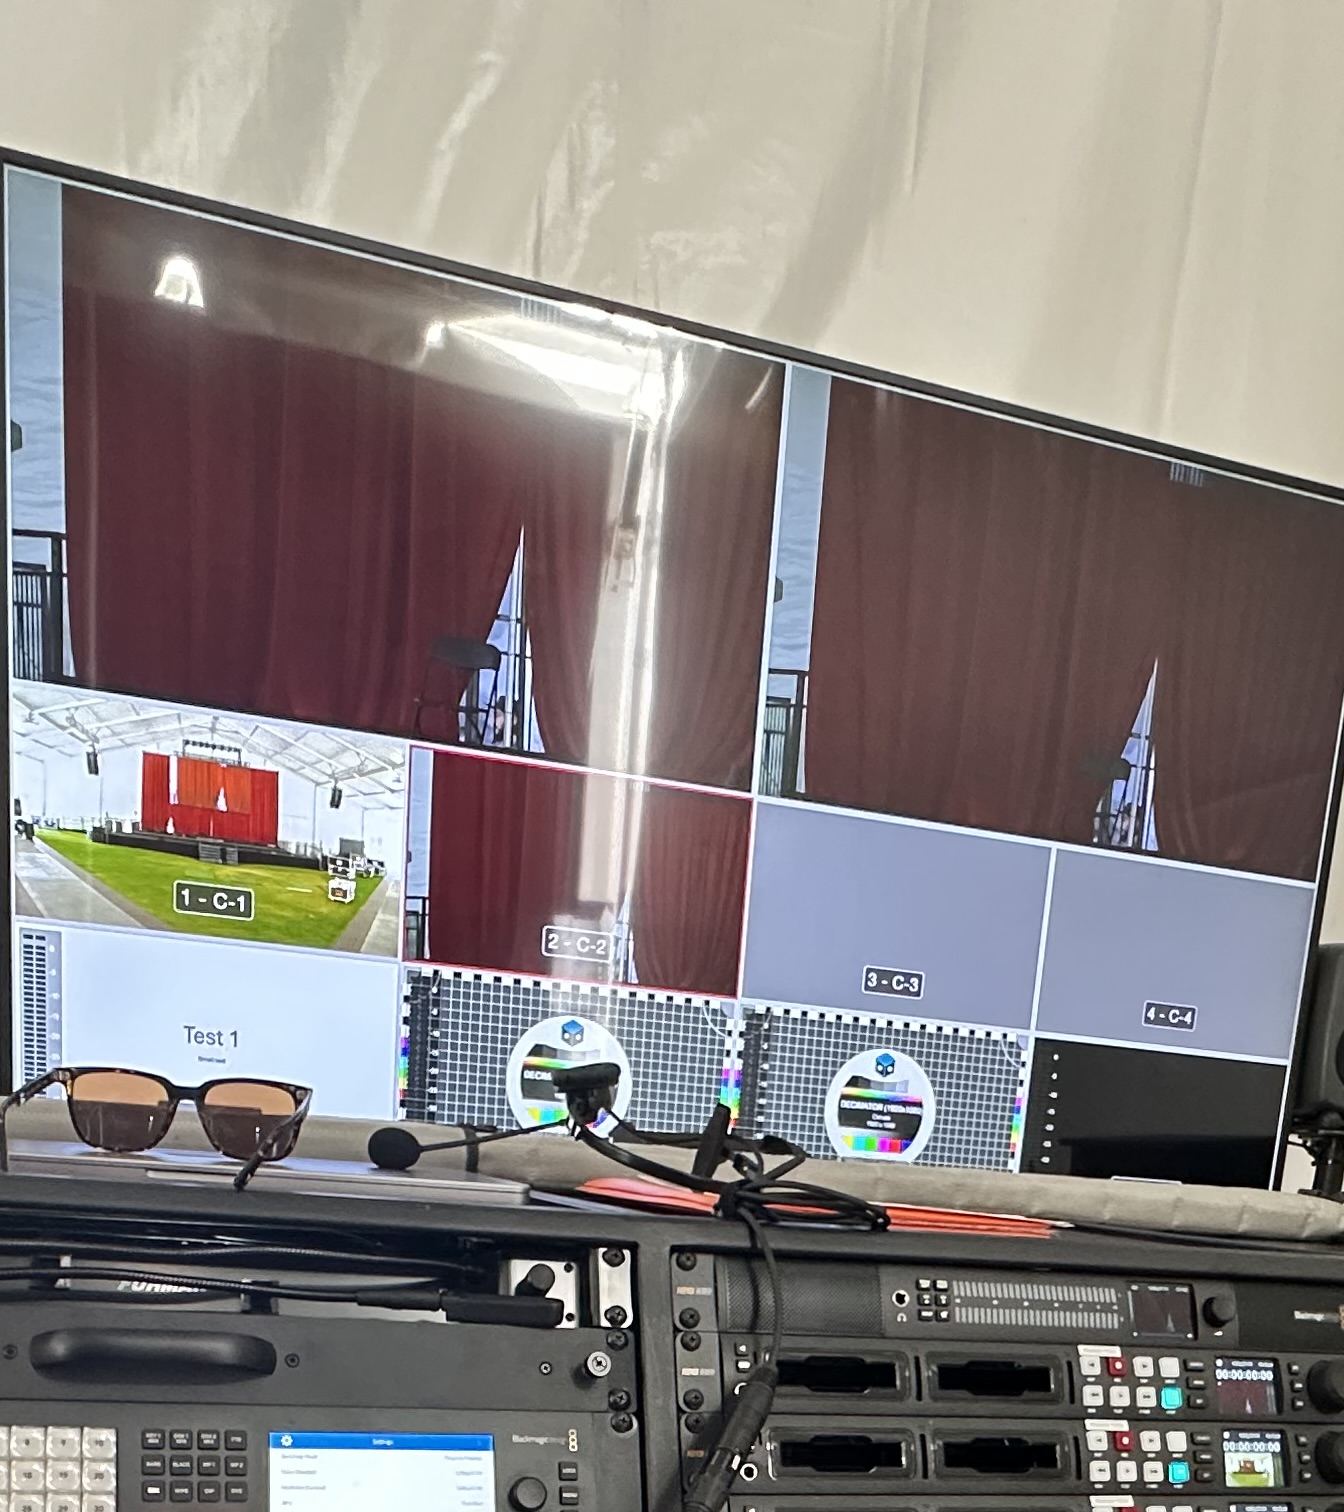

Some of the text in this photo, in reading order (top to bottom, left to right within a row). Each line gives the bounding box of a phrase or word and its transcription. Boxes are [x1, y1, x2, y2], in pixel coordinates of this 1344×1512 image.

[181, 888, 190, 906] 1
[213, 892, 245, 912] C-1
[548, 933, 560, 950] 2
[576, 936, 607, 955] C-2
[867, 971, 877, 987] 3
[891, 975, 919, 992] C-3
[1147, 1006, 1156, 1020] 4
[1168, 1009, 1192, 1025] C-4
[183, 1025, 238, 1048] Test 1
